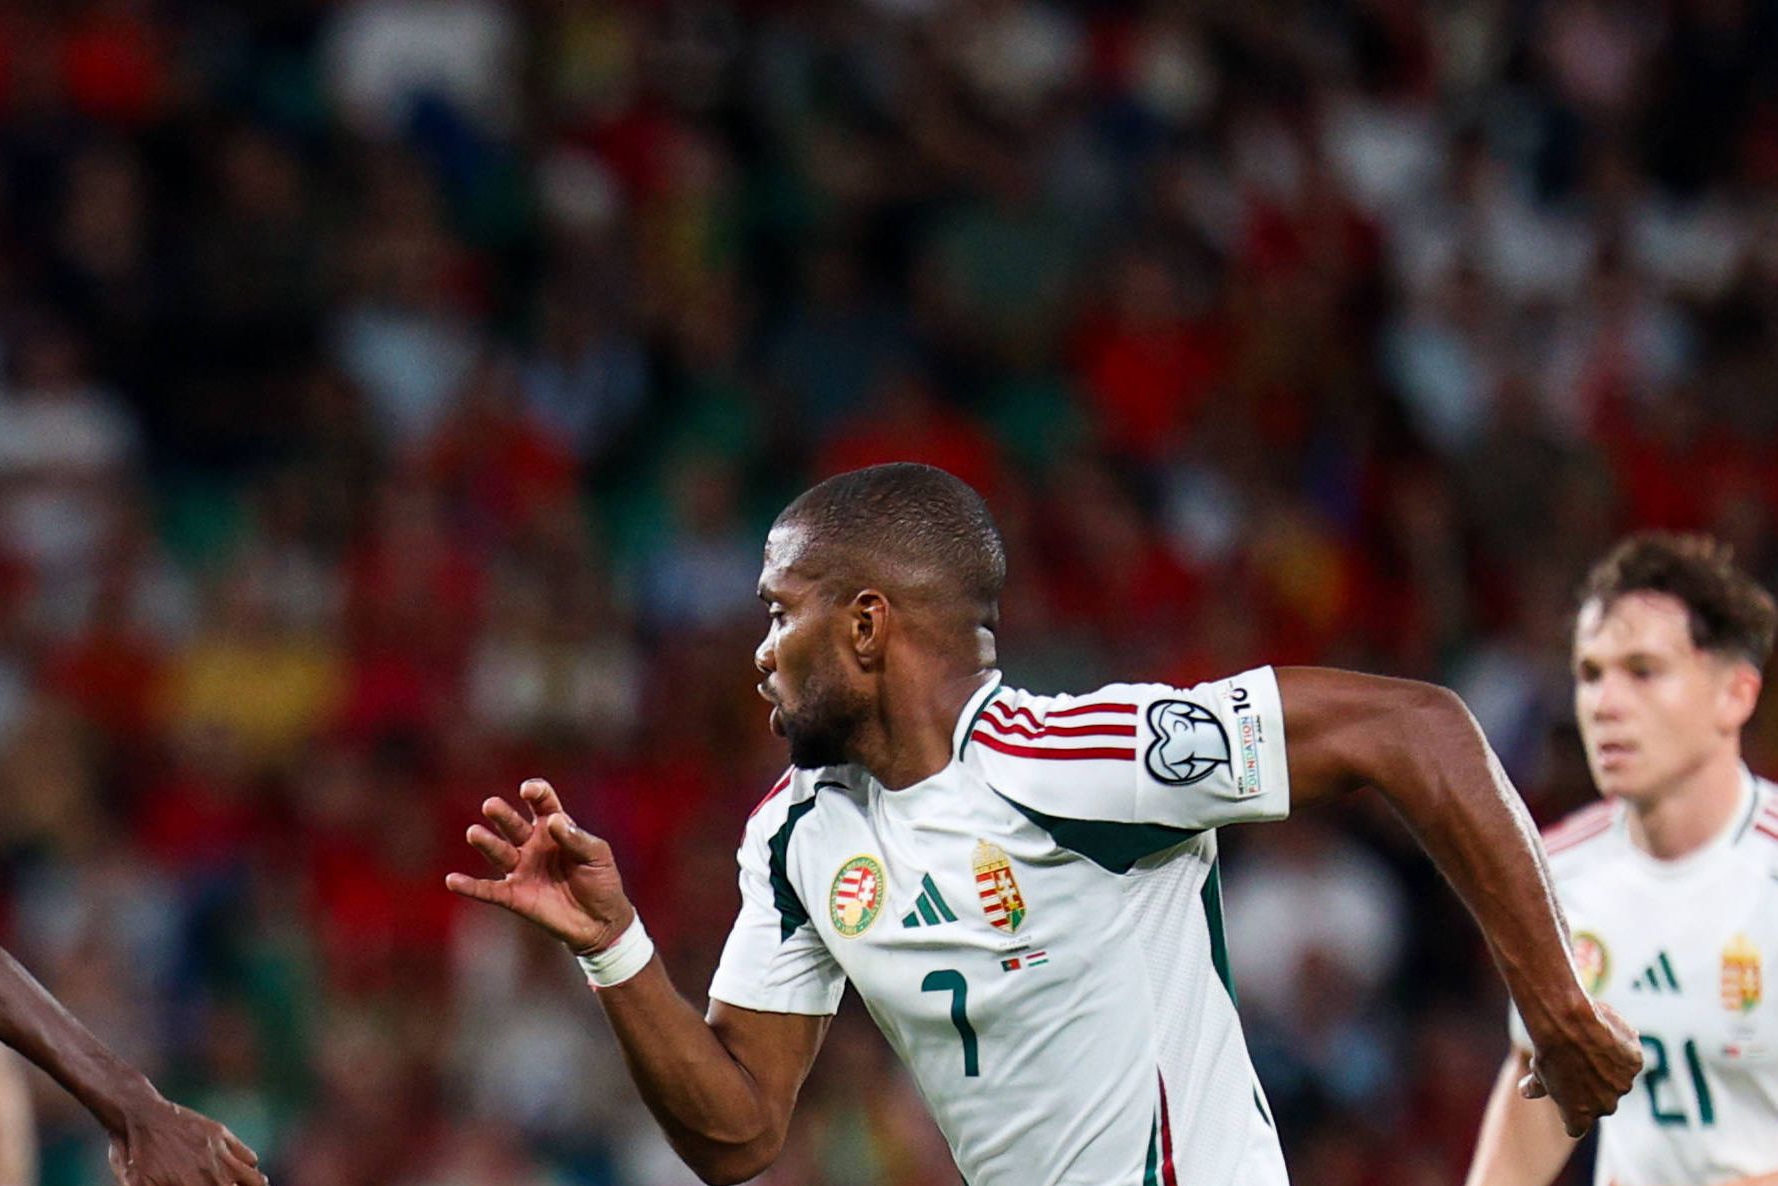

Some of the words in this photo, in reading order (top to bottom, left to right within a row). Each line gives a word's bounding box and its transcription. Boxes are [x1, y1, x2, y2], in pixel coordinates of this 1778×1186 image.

[1239, 715, 1258, 794] FOUNDATION
[921, 968, 979, 1077] 7
[1638, 1034, 1715, 1127] 21
